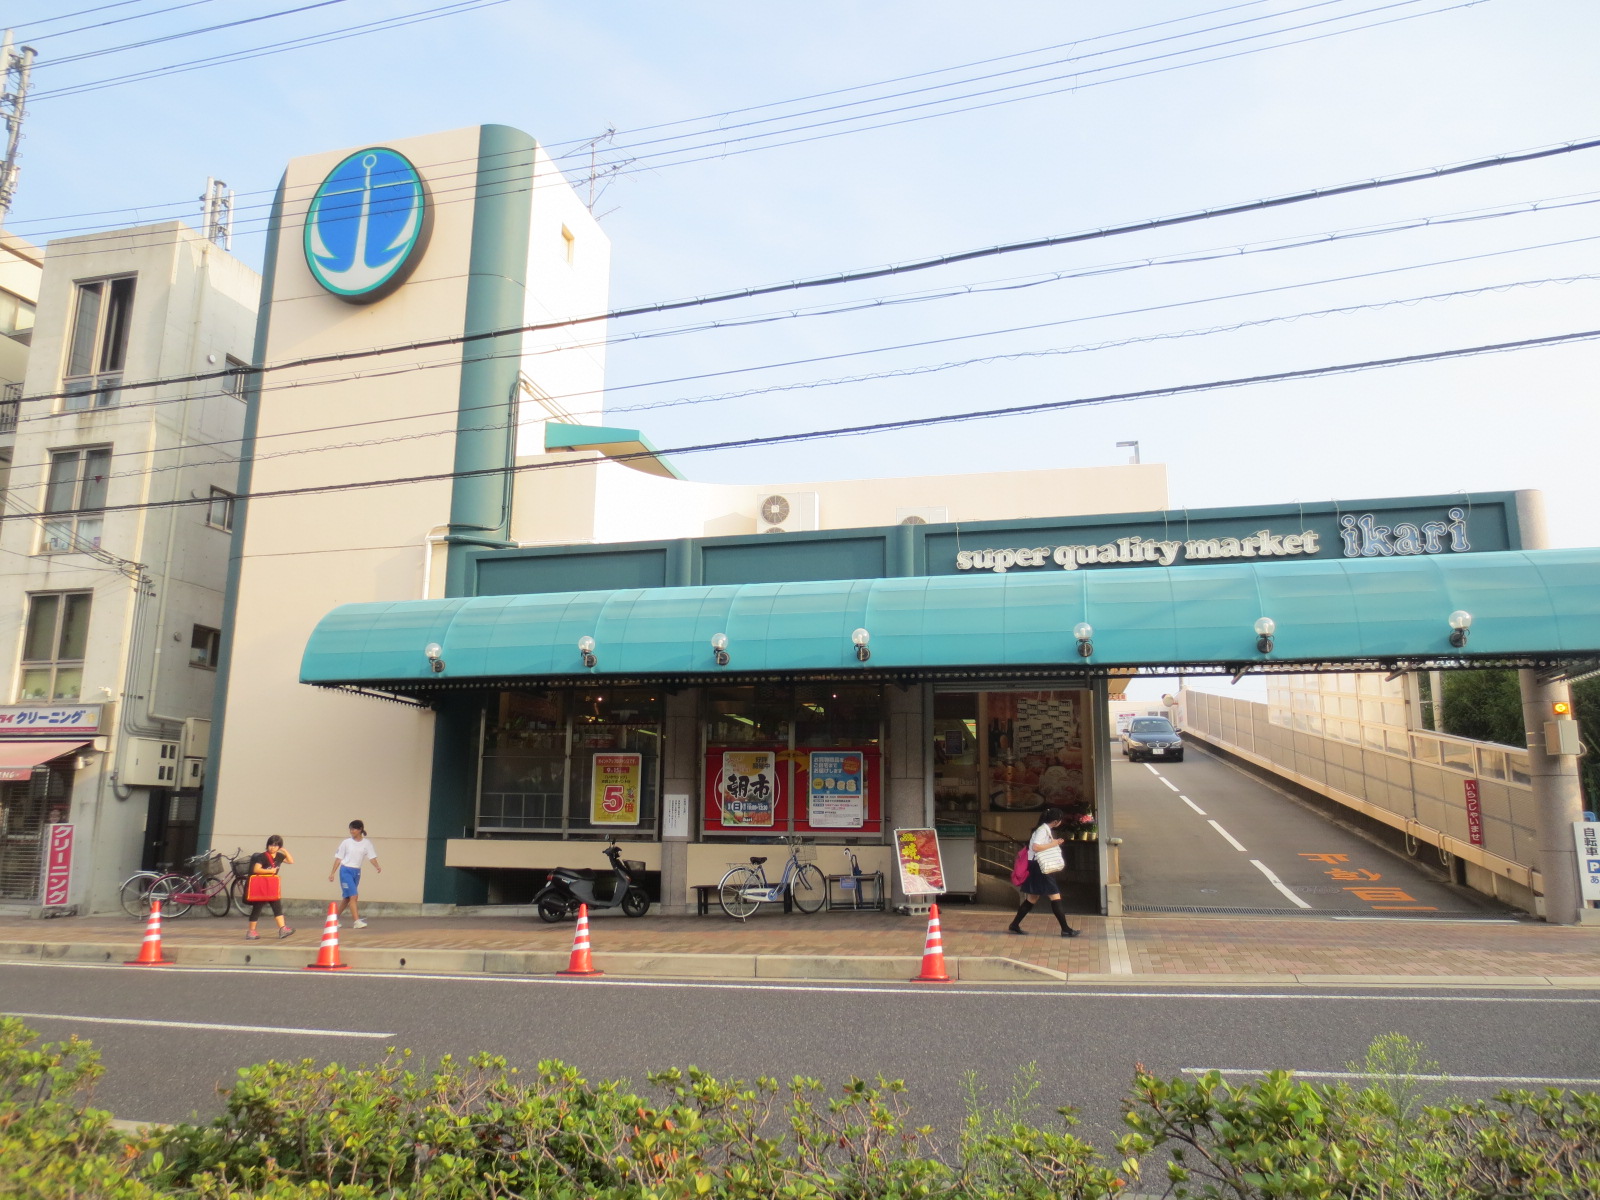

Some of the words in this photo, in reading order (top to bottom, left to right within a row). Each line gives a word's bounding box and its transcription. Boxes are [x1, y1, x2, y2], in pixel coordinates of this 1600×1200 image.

[957, 546, 1050, 573] super
[1054, 535, 1182, 571] quality
[1184, 529, 1320, 559] market
[1341, 507, 1471, 558] ikari
[727, 773, 770, 799] 朝市
[1465, 782, 1480, 841] いらっしゃいませ
[48, 825, 72, 904] クリーニング
[1583, 827, 1599, 856] 自転車
